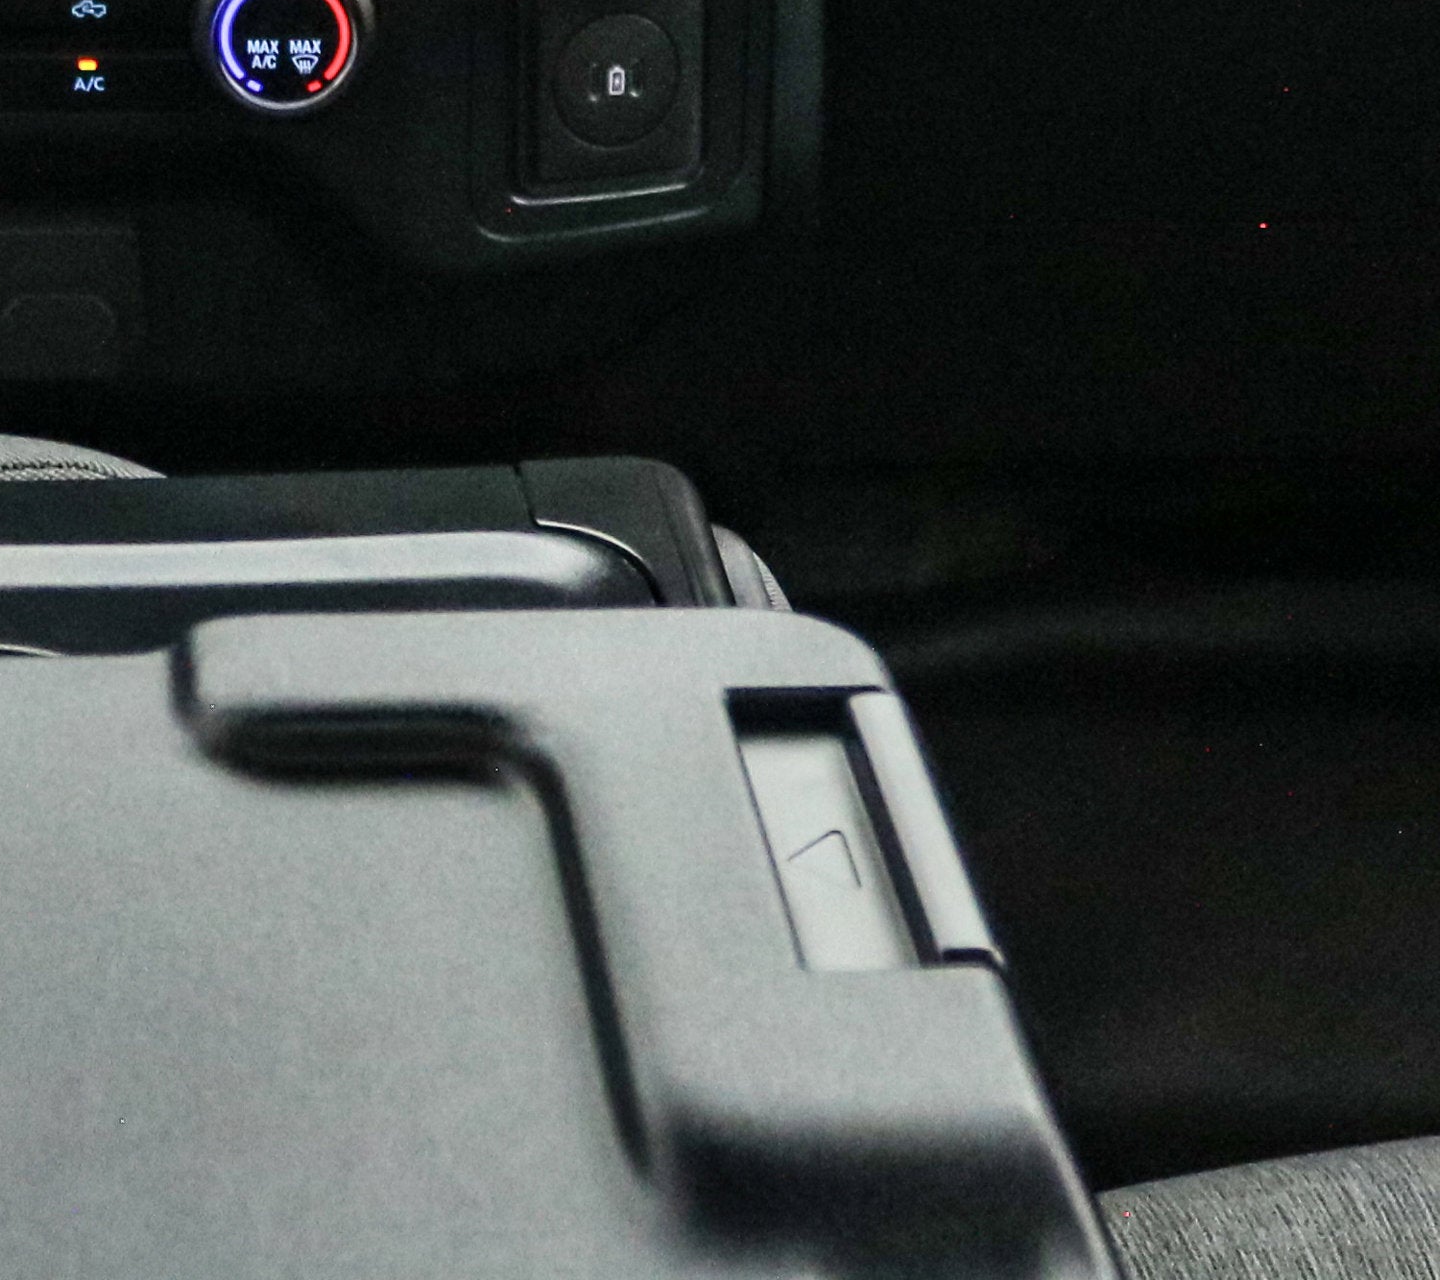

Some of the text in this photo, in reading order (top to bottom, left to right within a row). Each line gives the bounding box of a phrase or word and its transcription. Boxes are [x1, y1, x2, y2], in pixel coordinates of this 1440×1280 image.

[247, 40, 279, 55] MAX
[290, 40, 322, 55] MAX
[252, 55, 276, 70] A/C
[74, 76, 105, 92] A/C
